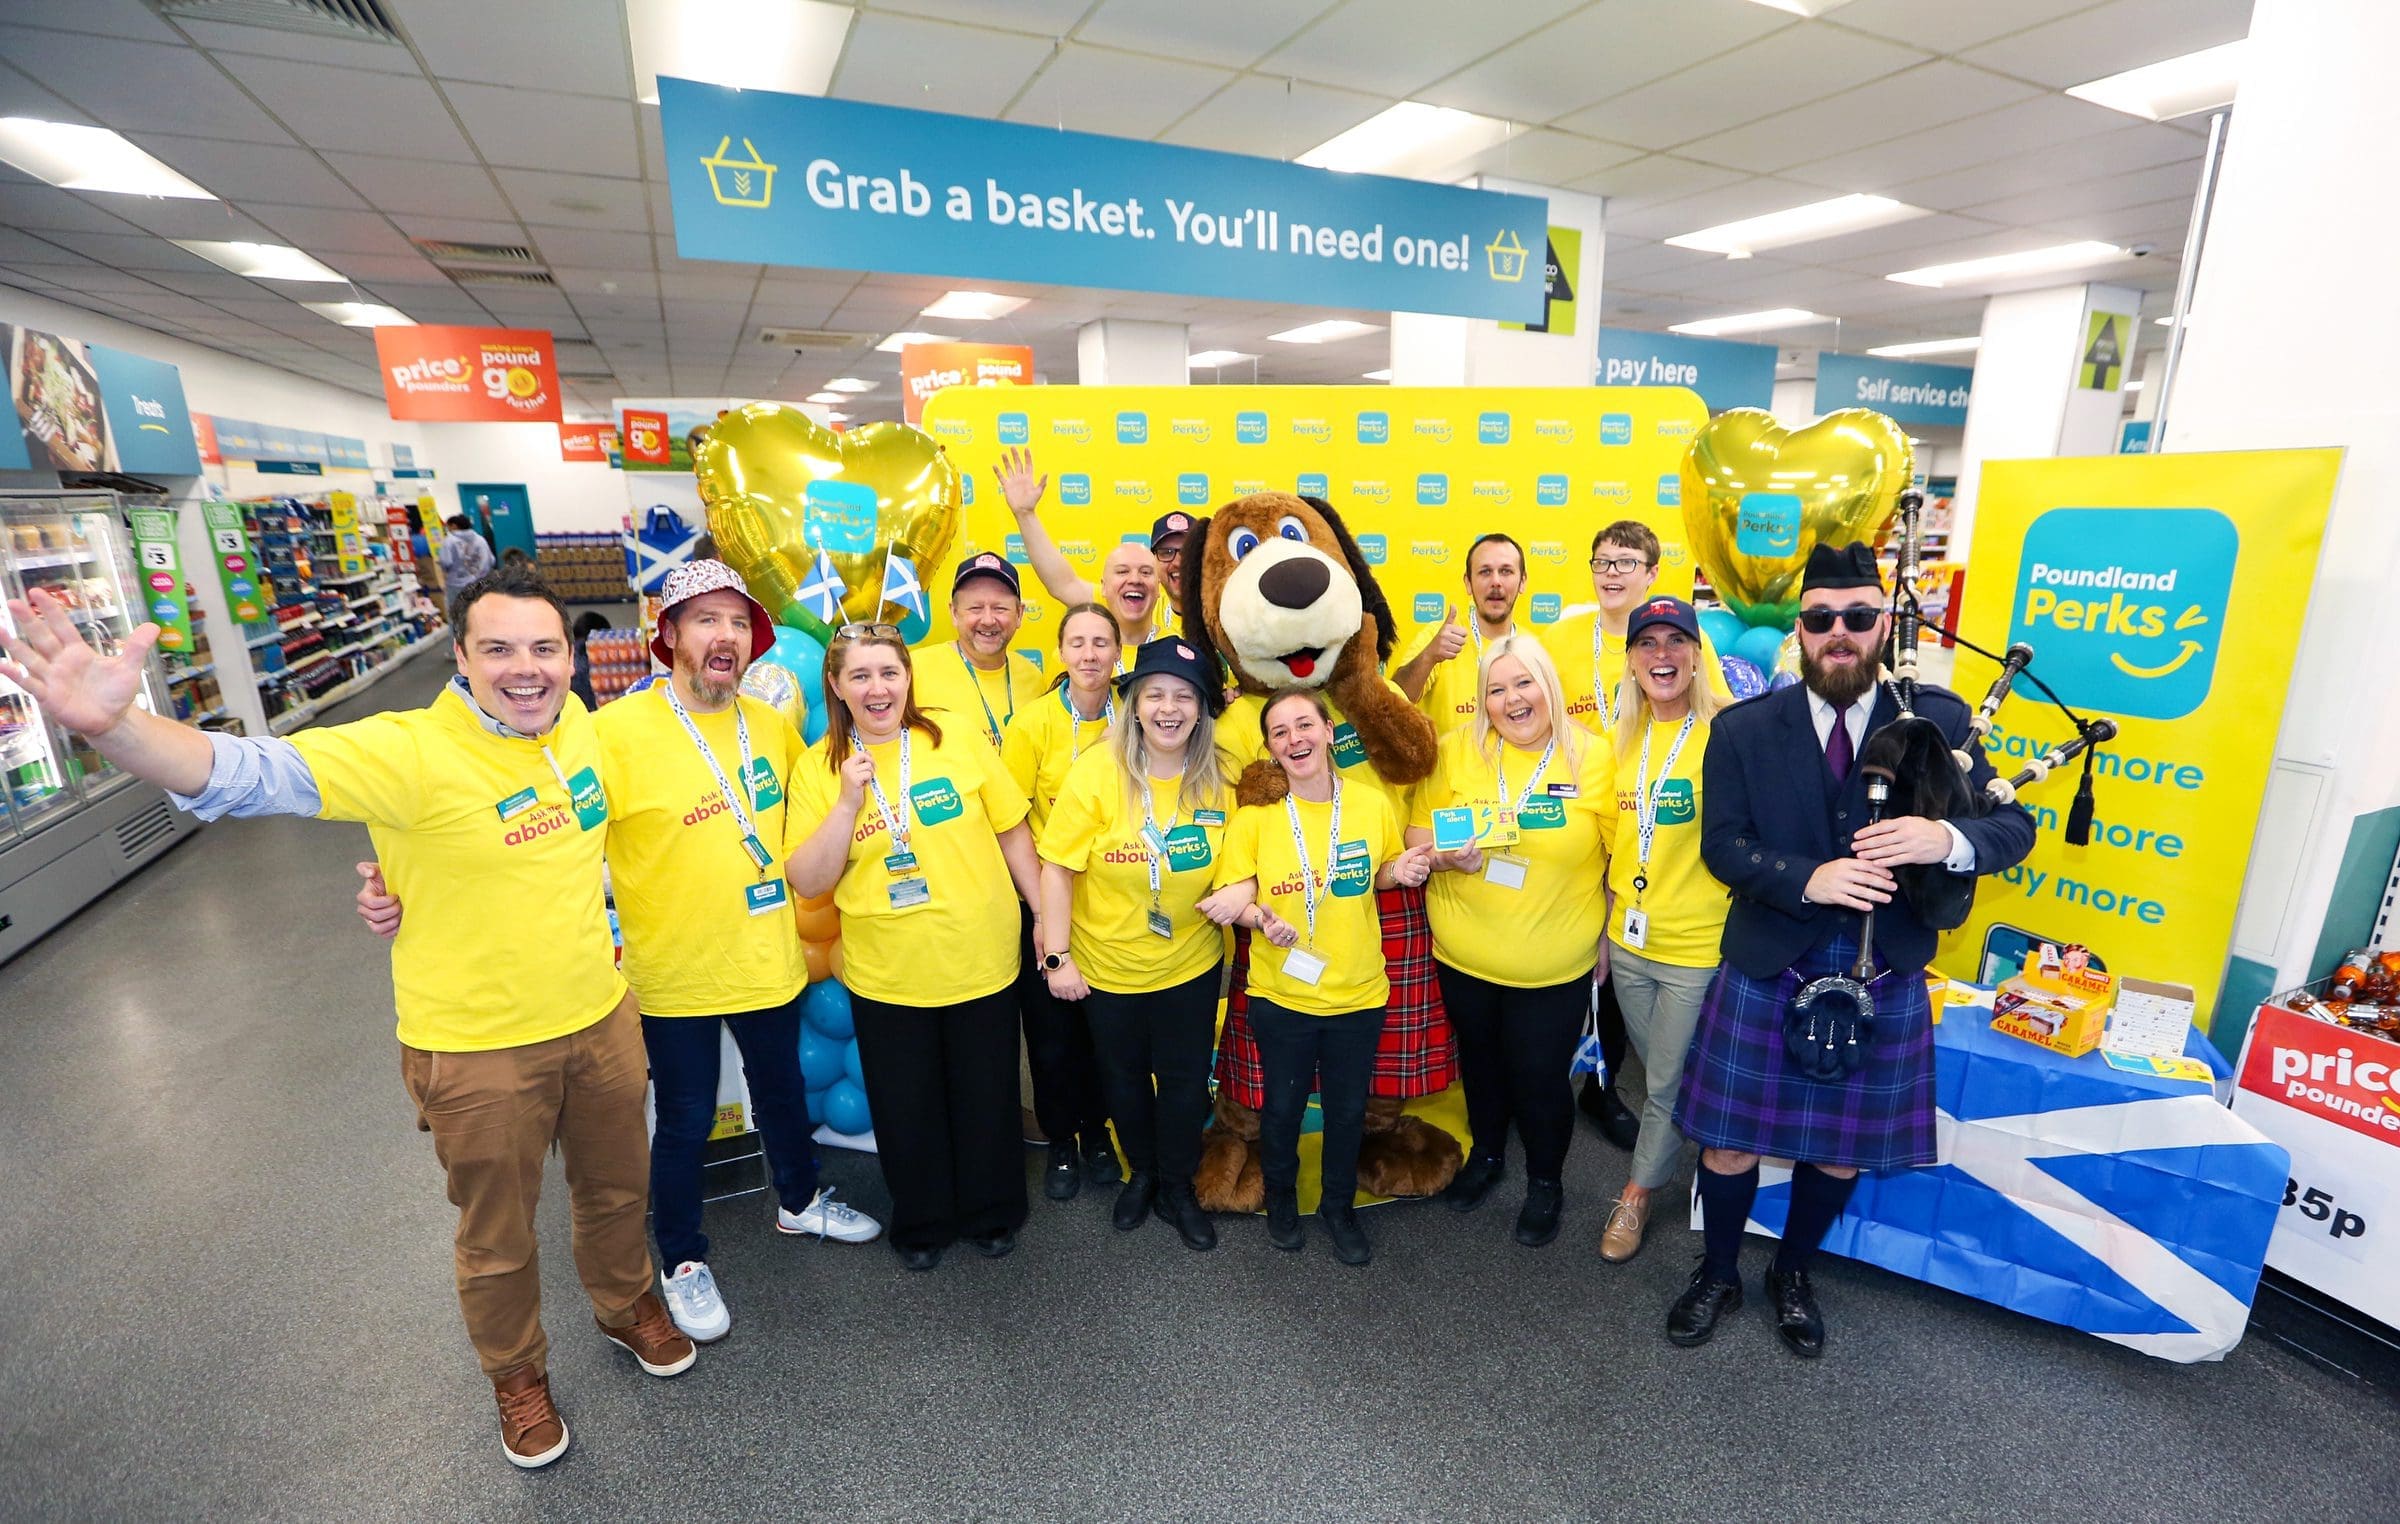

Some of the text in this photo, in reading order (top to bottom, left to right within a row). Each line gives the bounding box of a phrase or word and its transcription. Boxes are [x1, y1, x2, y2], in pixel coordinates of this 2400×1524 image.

[805, 158, 931, 217] Grab
[945, 185, 973, 221] a
[987, 178, 1155, 239] basket.
[1290, 224, 1382, 263] need
[1393, 234, 1469, 272] one!
[481, 350, 541, 366] pound
[391, 357, 461, 388] price
[977, 363, 1022, 378] pound
[1607, 355, 1698, 386] pay here
[406, 380, 470, 393] pounders
[910, 368, 962, 396] price
[1857, 375, 1890, 401] Self
[1890, 382, 1947, 407] service
[934, 424, 965, 435] Perks
[1053, 424, 1083, 435] Perks
[1172, 425, 1203, 434] Perks
[1293, 424, 1324, 434] Perks
[1414, 424, 1445, 434] Perks
[1536, 425, 1566, 435] Perks
[1658, 425, 1689, 435] Perks
[1116, 486, 1145, 496] Perks
[1353, 486, 1384, 496] Perks
[1473, 486, 1504, 496] Perks
[1593, 487, 1624, 497] Perks
[809, 507, 861, 527] Perks
[1742, 519, 1784, 536] Perks
[1060, 545, 1089, 555] Perks
[1412, 546, 1442, 556] Perks
[1530, 546, 1561, 556] Perks
[2030, 562, 2177, 592] Poundland
[2023, 588, 2166, 638] Perks
[1333, 739, 1360, 755] Perks
[1984, 723, 2204, 790] Sav more
[755, 776, 774, 792] erks
[701, 790, 718, 804] Ask
[917, 794, 950, 811] Perks
[1658, 797, 1682, 808] erks
[529, 809, 548, 822] Ask
[683, 800, 731, 826] abou
[1499, 811, 1516, 823] £1
[1520, 805, 1554, 815] Perks
[504, 811, 570, 846] about
[1123, 842, 1140, 850] Ask
[1169, 843, 1200, 856] Perks
[1104, 849, 1149, 863] abou
[1334, 868, 1363, 881] Perks
[1271, 876, 1323, 896] abot
[2055, 877, 2166, 925] more
[2061, 973, 2109, 993] CARAMEL
[1997, 1019, 2053, 1047] CARAMEL
[2286, 1080, 2400, 1132] pounde
[720, 1111, 742, 1122] 25p
